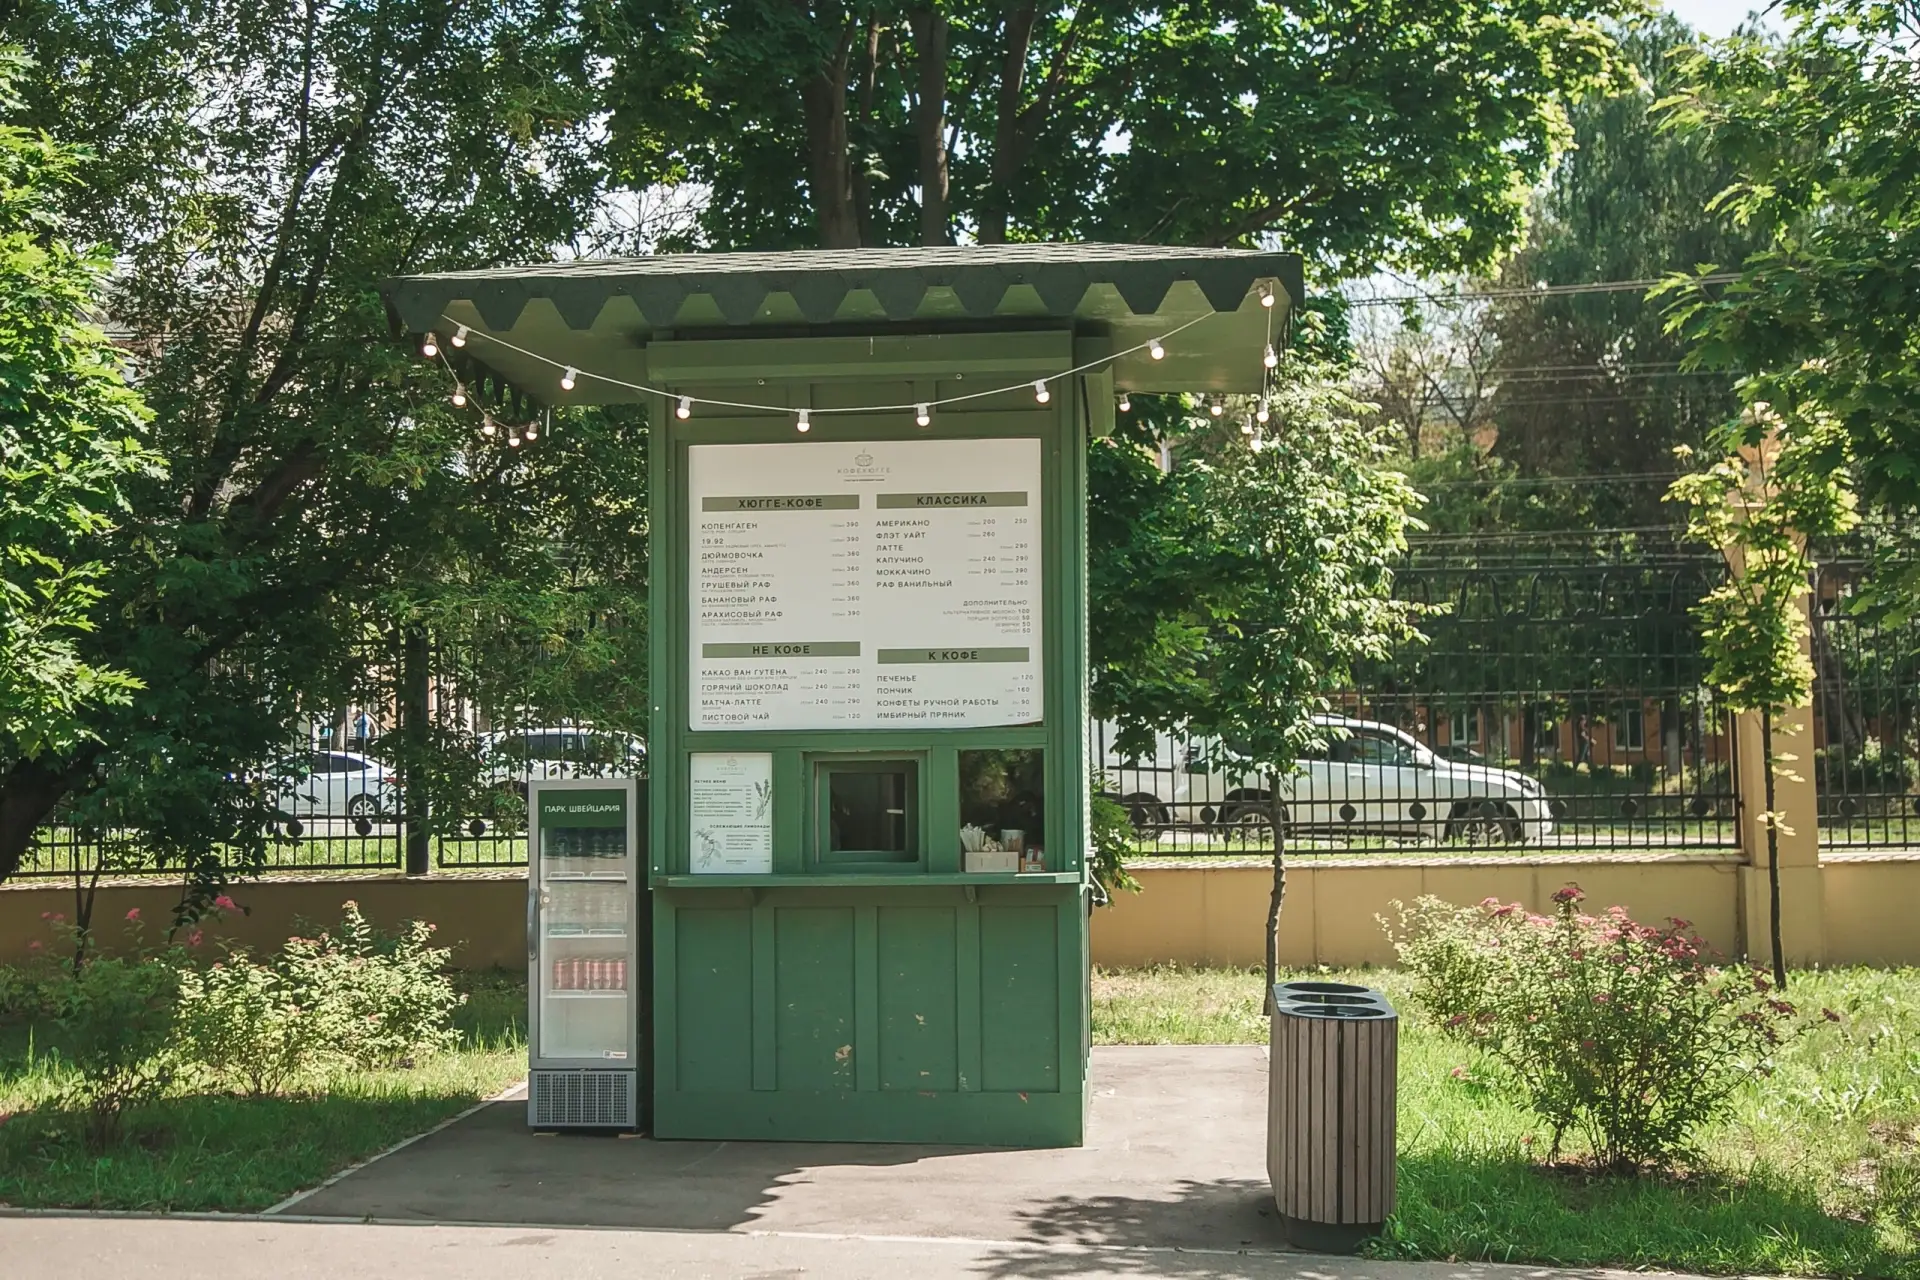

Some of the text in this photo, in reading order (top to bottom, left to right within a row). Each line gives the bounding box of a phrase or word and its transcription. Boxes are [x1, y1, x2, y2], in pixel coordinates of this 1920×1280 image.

[738, 498, 823, 509] ХЮГГЕ-КОФЕ
[917, 495, 987, 506] КЛАССИКА
[904, 531, 926, 539] УАЙТ
[701, 552, 764, 560] ДЮЙМОВОЧКА
[876, 568, 931, 576] МОККАЧИНО
[701, 580, 749, 589] ГРУШЕВЫЙ
[898, 580, 952, 588] ВАНИЛЬНЫЙ
[702, 596, 756, 604] БАНАНОВЫЙ
[702, 610, 761, 618] АРАХИСОВЫЙ
[752, 645, 810, 654] НЕ КОФЕ
[928, 651, 978, 660] К КОФЕ
[701, 683, 742, 691] ГОРЯЧИЙ
[877, 687, 913, 695] ПОНЧИК
[923, 698, 960, 706] РУЧНОЙ
[752, 712, 770, 720] ЧАЙ
[877, 711, 927, 719] ИМБИРНЫЙ
[544, 804, 620, 813] ПАРК ШВЕЙЦАРИЯ
